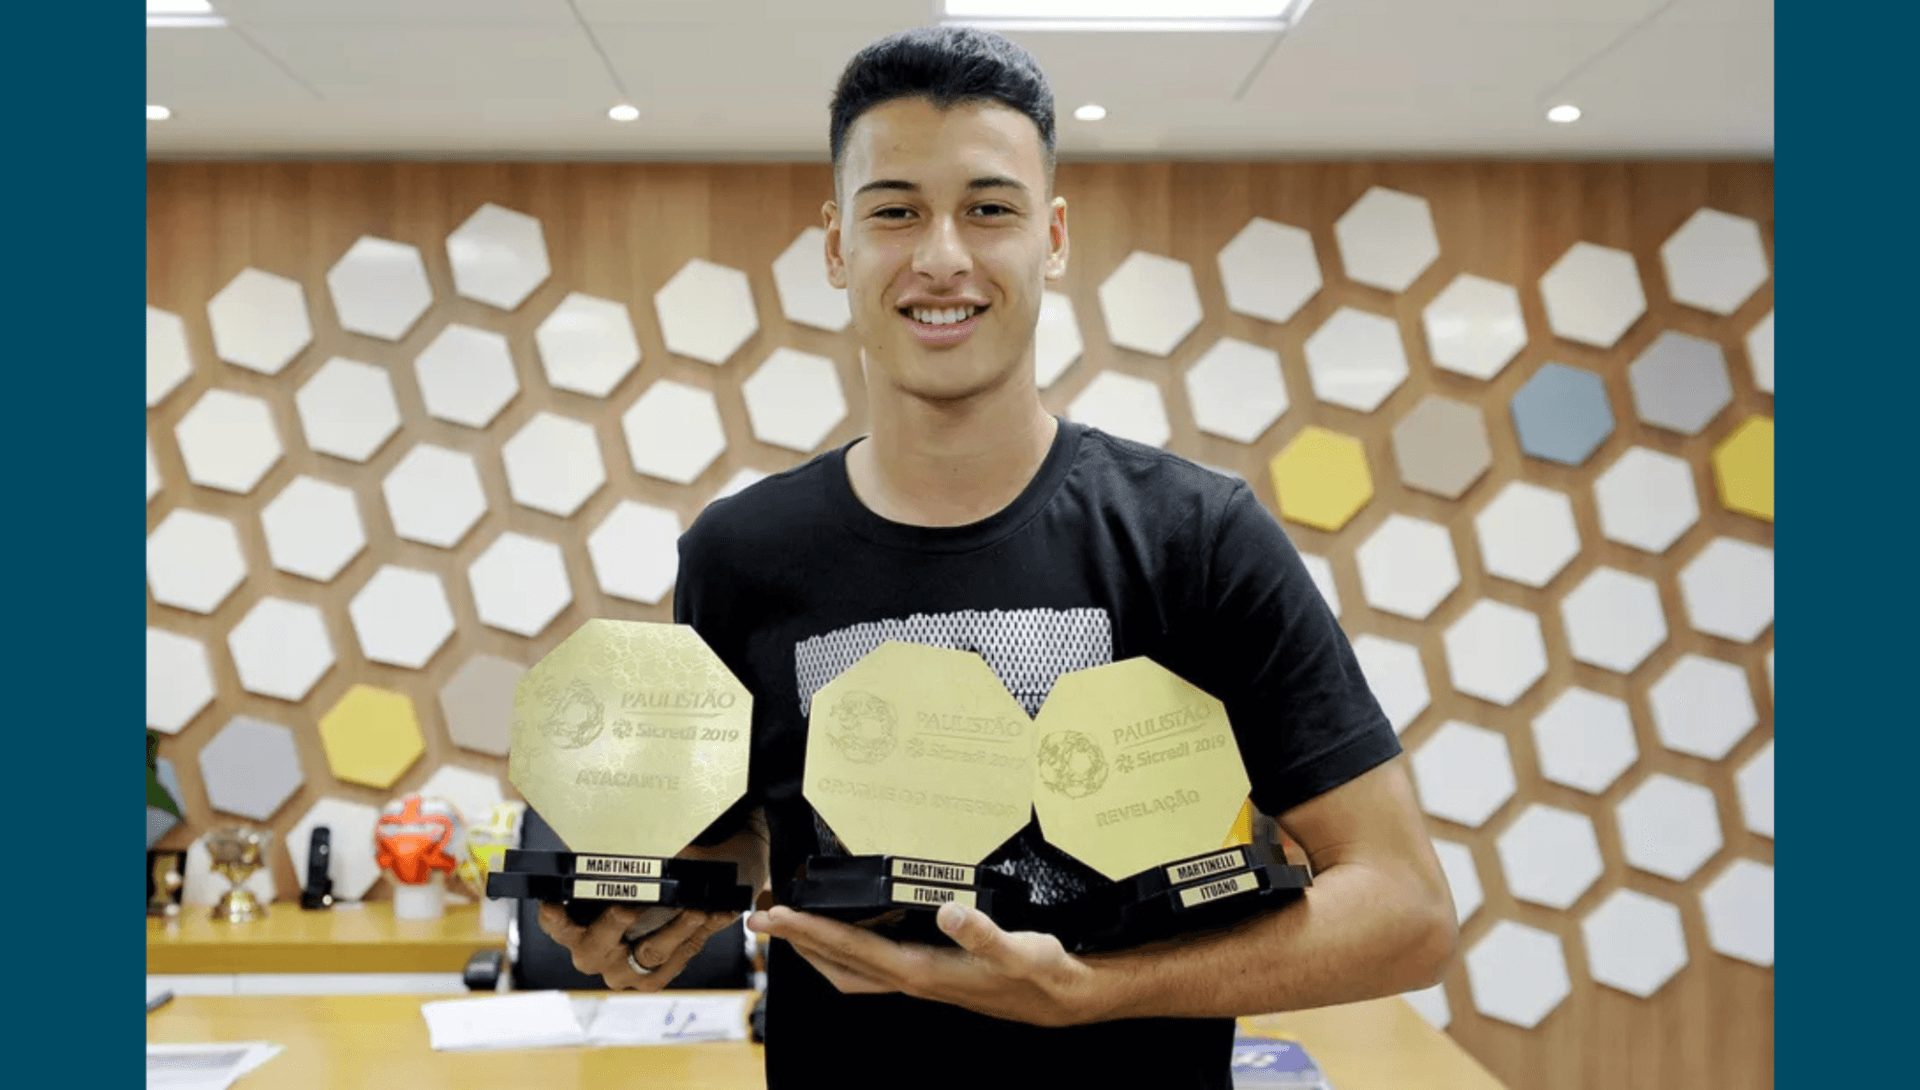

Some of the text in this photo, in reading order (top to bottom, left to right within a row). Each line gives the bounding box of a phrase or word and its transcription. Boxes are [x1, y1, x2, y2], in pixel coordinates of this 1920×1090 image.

[620, 689, 736, 709] PAULISTÃO
[635, 721, 740, 743] Sicredi 2019
[916, 710, 1024, 737] PAULISTÃO
[1113, 704, 1210, 745] PAULISTÃO
[1137, 733, 1227, 768] Sicredi 2019
[575, 768, 680, 791] ATACANTE
[1095, 788, 1201, 828] REVELAÇÃO
[586, 858, 651, 875] MARTINELLI
[902, 862, 964, 881] MARTINELLI
[1177, 855, 1236, 879] MARTINELLI
[596, 883, 638, 898] ITUANO
[914, 887, 955, 903] ITUANO
[1200, 878, 1238, 900] ITUANO
